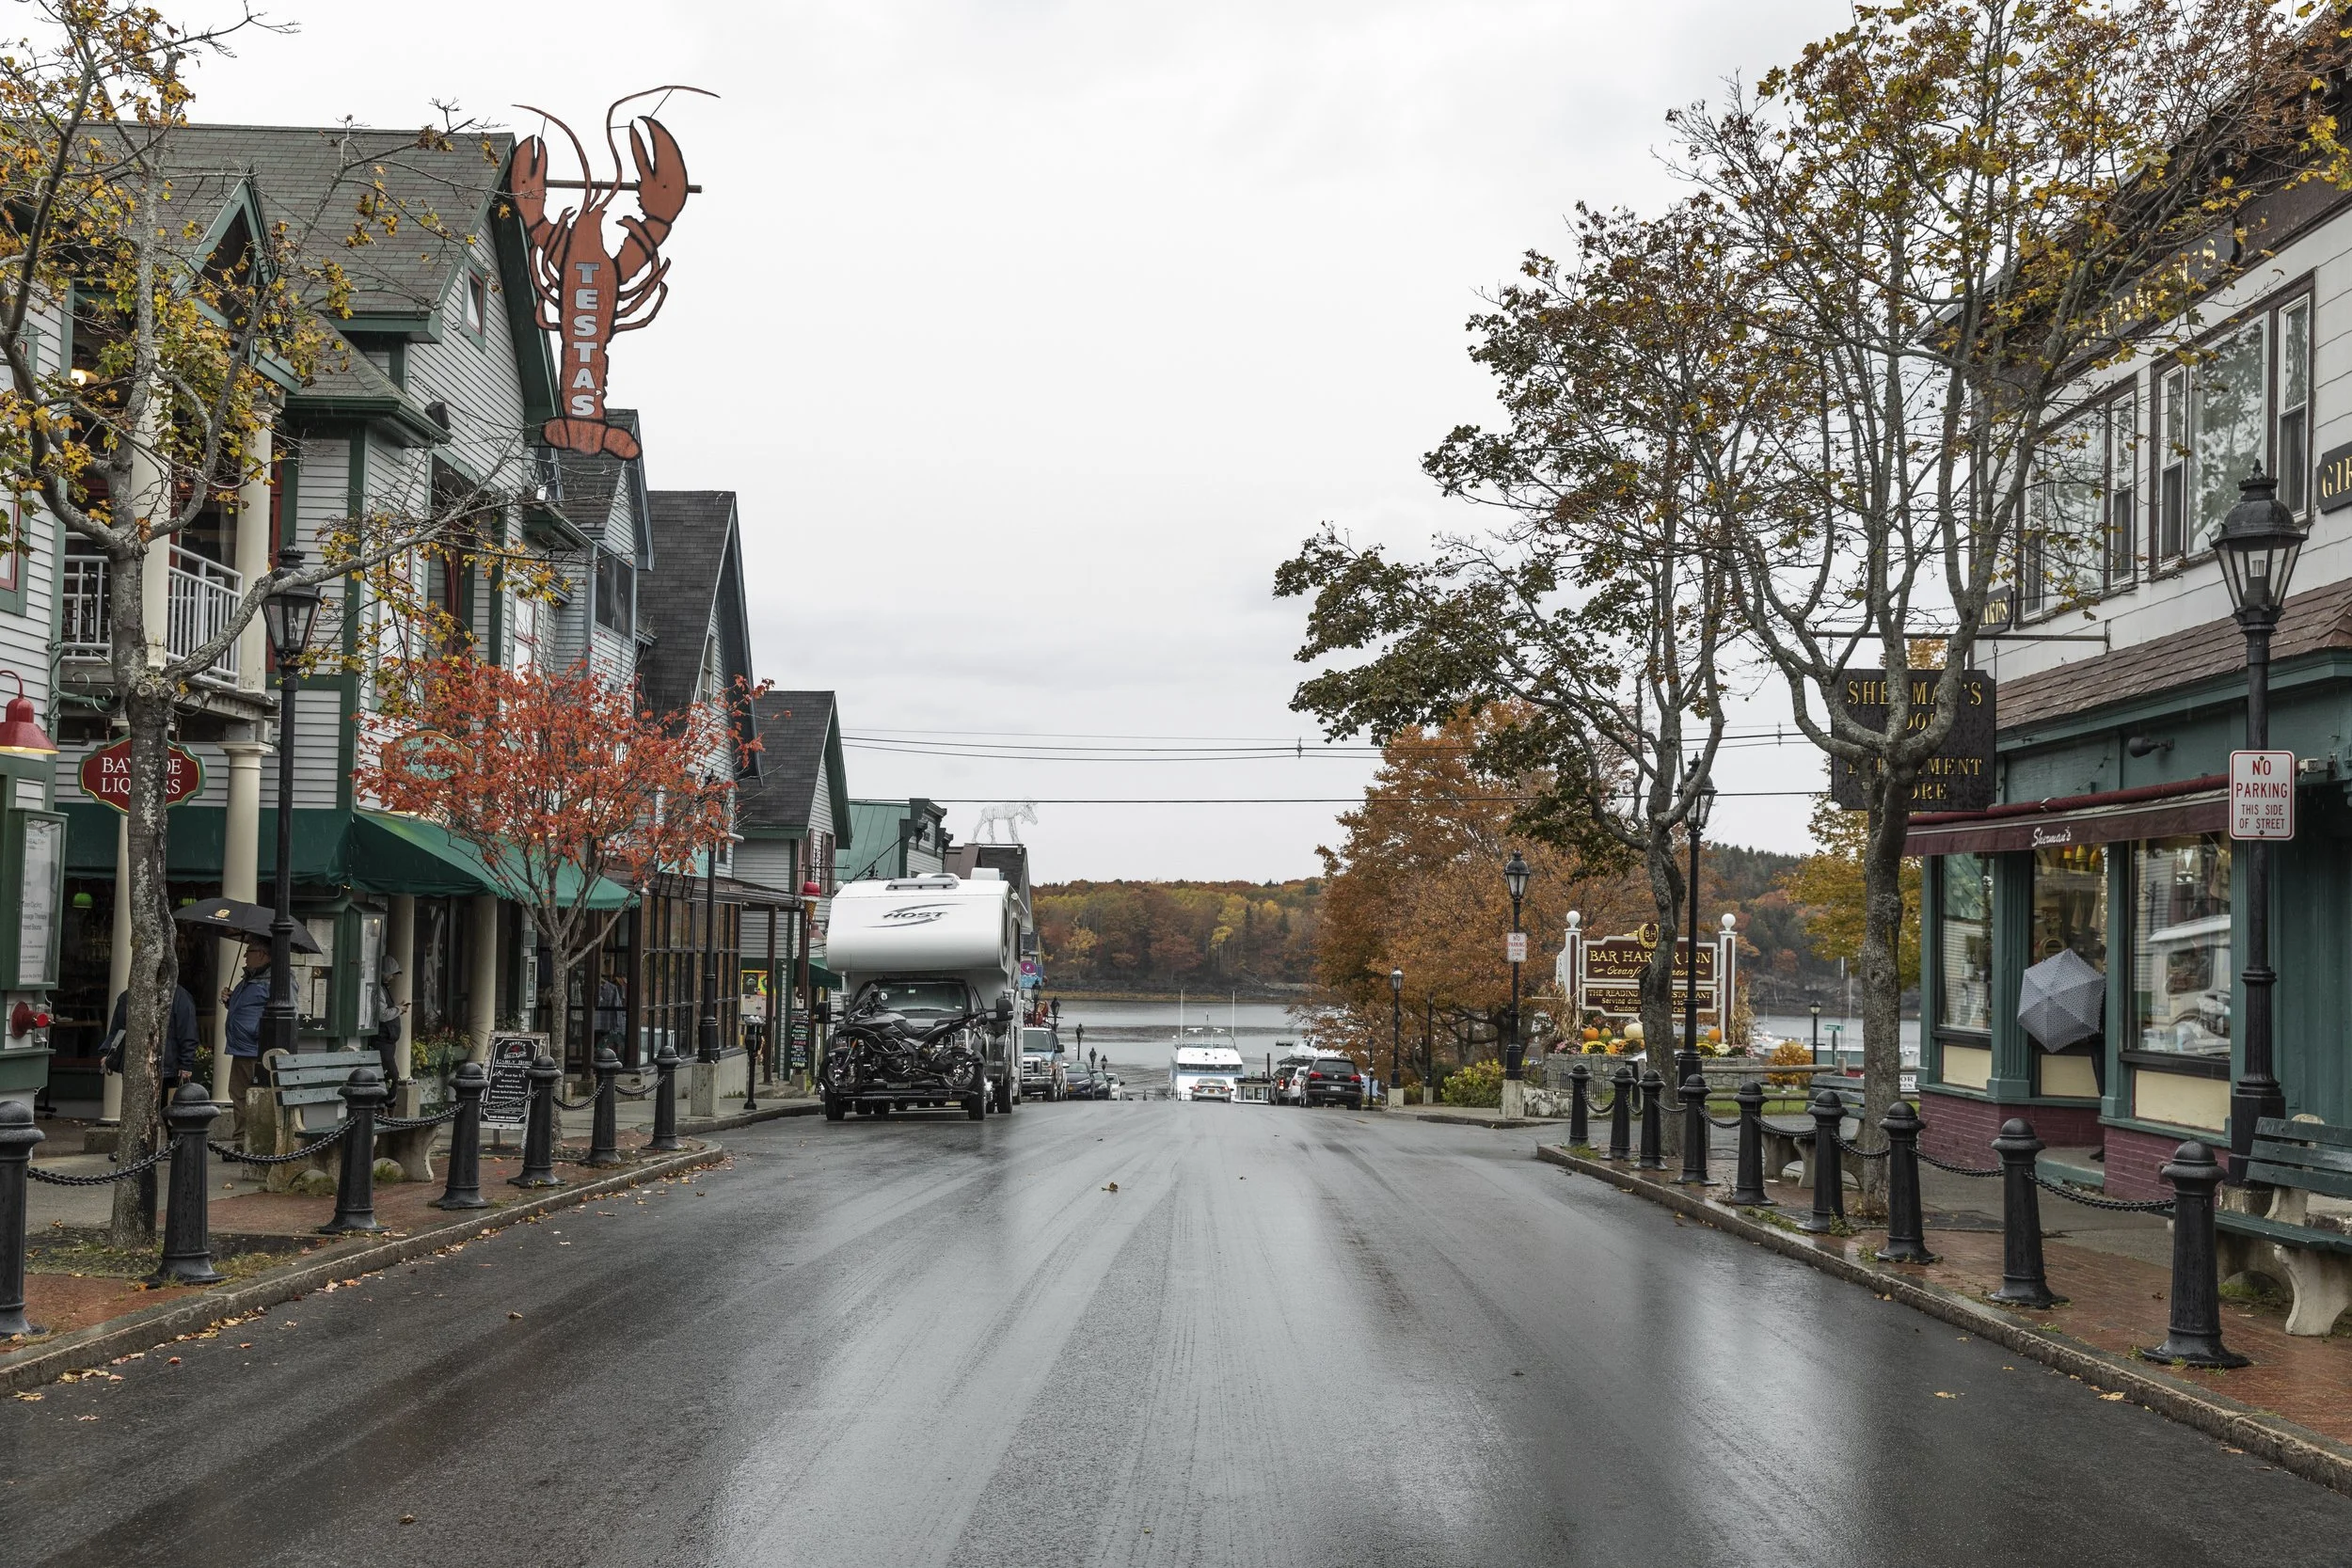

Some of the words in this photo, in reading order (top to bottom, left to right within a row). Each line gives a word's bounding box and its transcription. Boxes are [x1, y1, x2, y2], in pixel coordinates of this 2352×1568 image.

[571, 262, 601, 417] TESTA'S
[2252, 760, 2271, 776] NO
[2236, 783, 2287, 798] PARKING
[2242, 804, 2258, 816] THIS
[2265, 804, 2283, 816] SIDE
[2239, 818, 2249, 829] OF
[2256, 817, 2285, 829] STREET
[2031, 827, 2071, 847] Sherman's
[1589, 950, 1619, 964] BAR
[1588, 989, 1603, 997] THE
